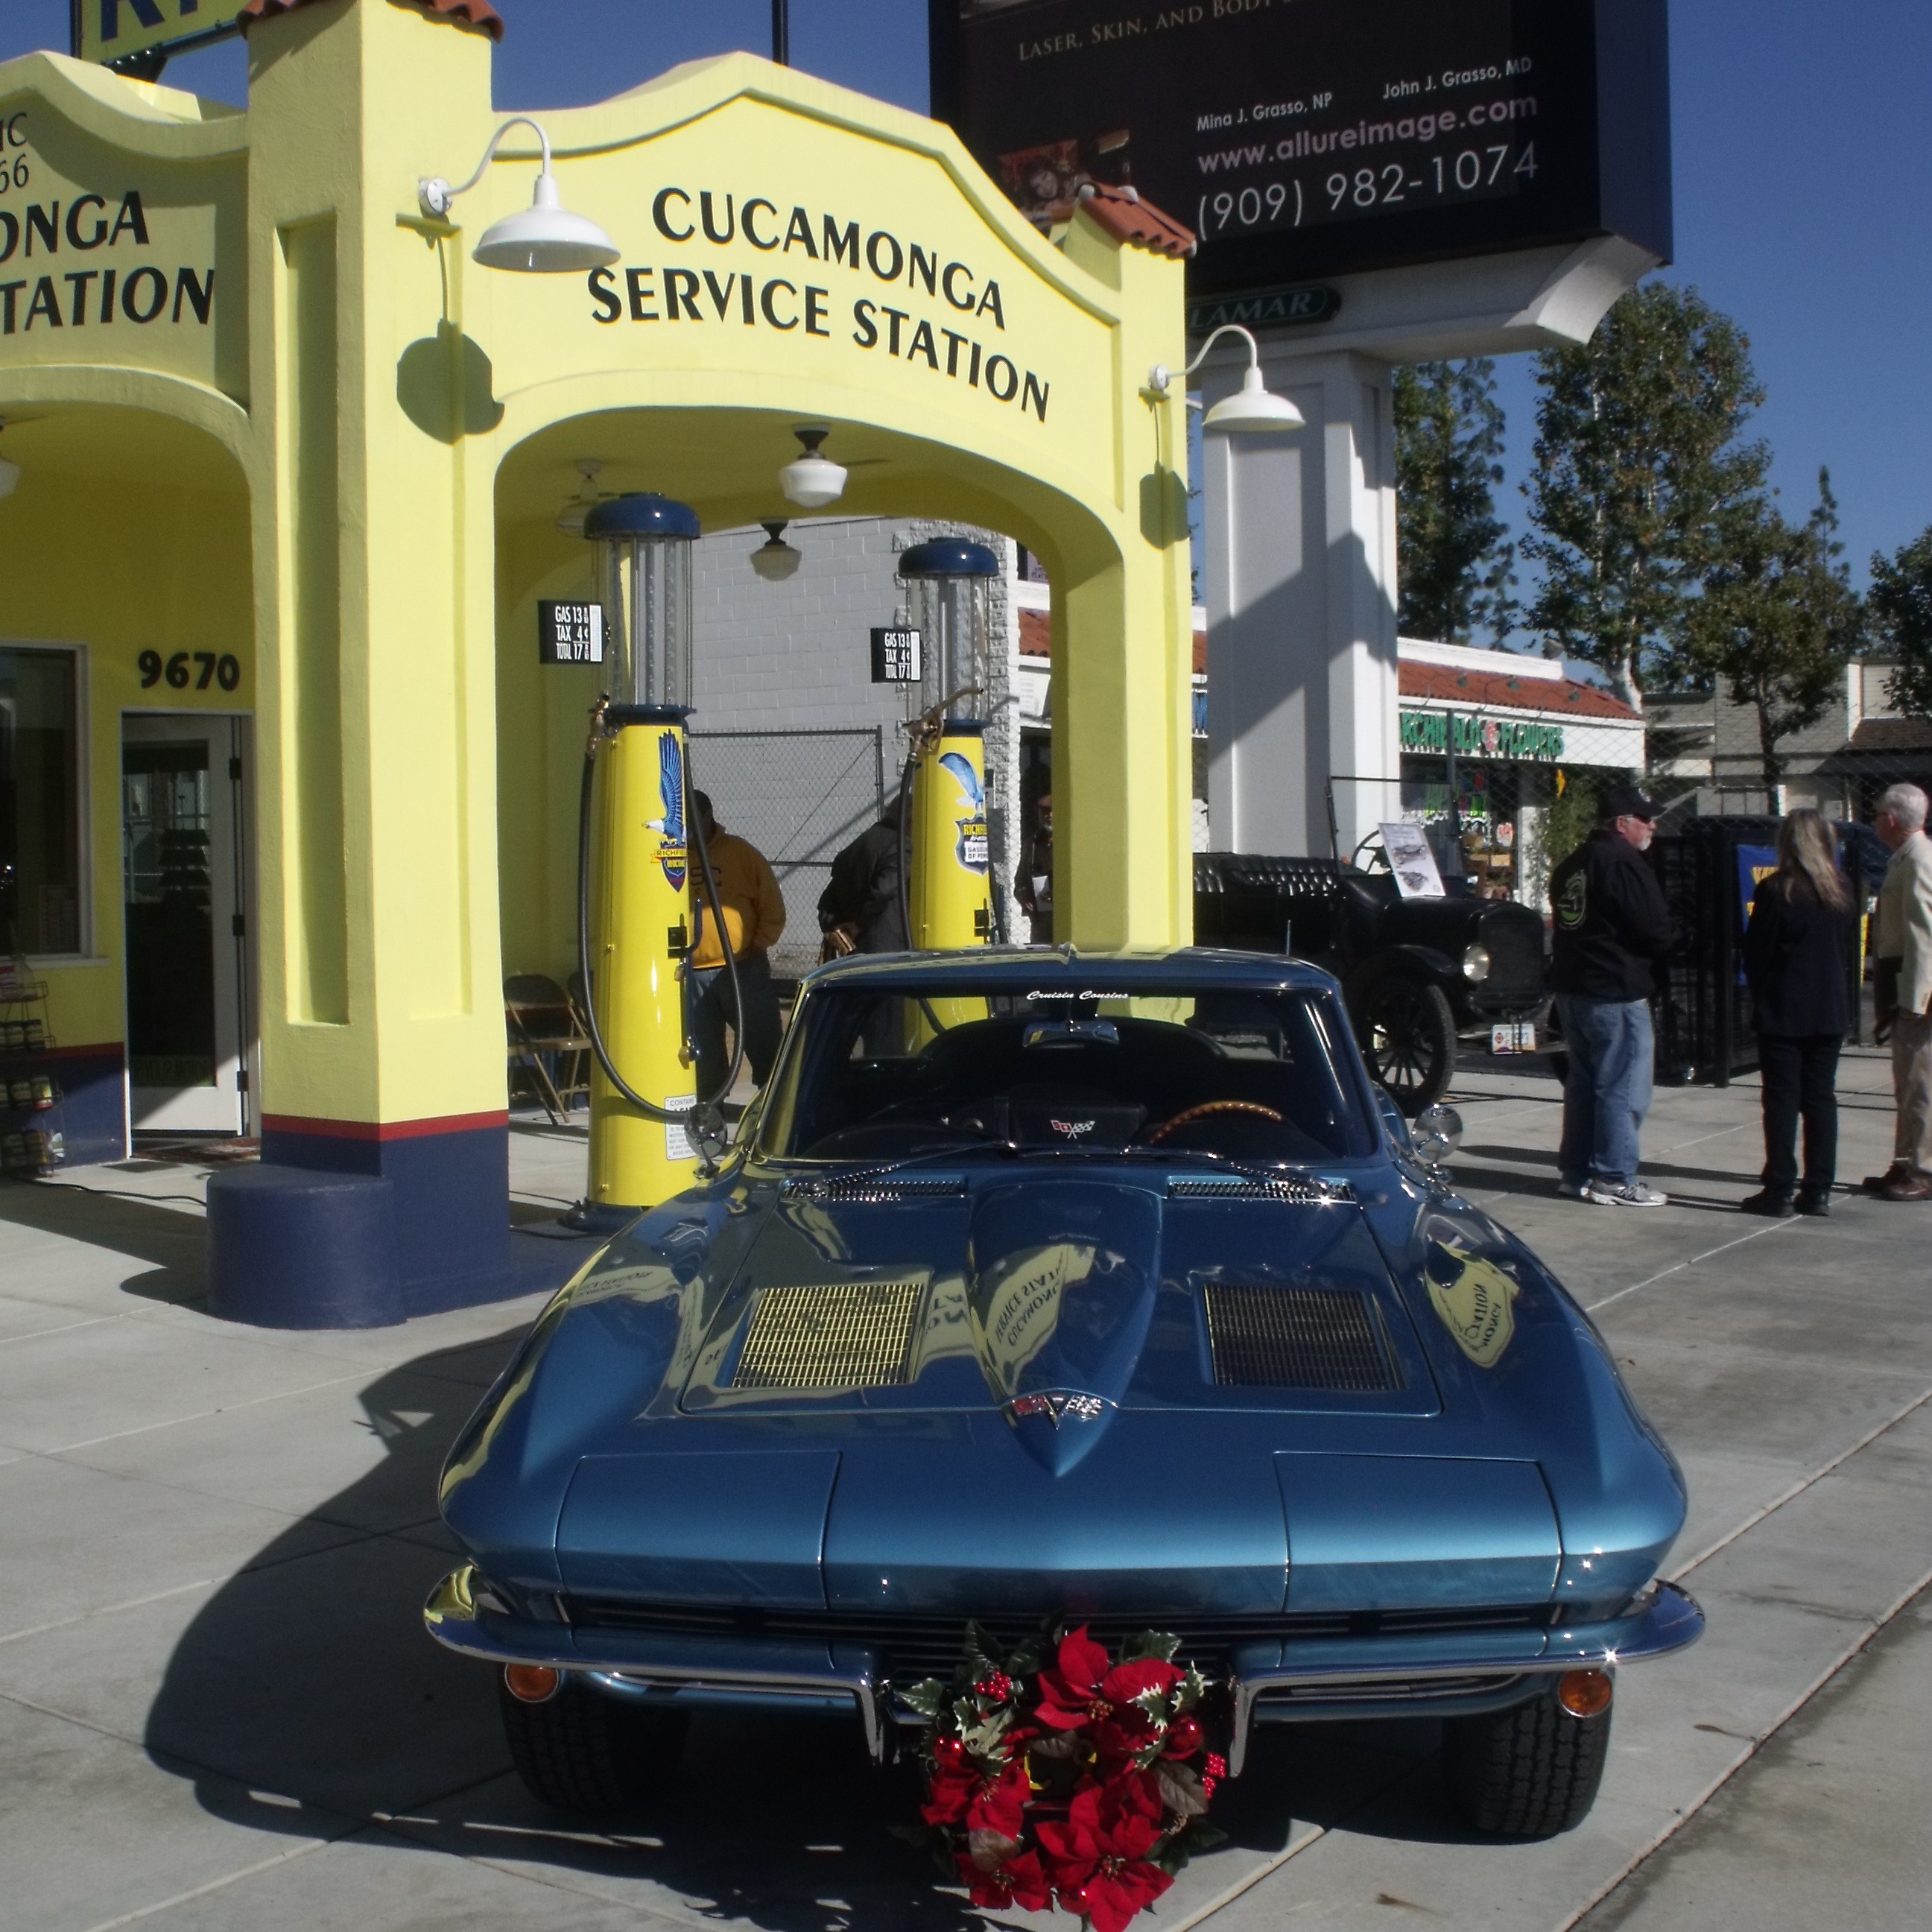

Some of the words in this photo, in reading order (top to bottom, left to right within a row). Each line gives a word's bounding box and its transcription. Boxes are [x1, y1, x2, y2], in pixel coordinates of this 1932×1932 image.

[1382, 80, 1419, 99] John
[1425, 75, 1437, 91] J.
[1442, 66, 1501, 87] Grasso,
[1505, 56, 1532, 76] MD
[1197, 113, 1232, 131] Mina
[1237, 108, 1248, 123] J.
[1252, 101, 1308, 120] Grasso,
[1312, 91, 1332, 110] NP
[1197, 95, 1537, 174] www.allureimage.com
[1198, 179, 1303, 241] (909)
[1326, 142, 1539, 212] 982-1074
[652, 187, 1005, 332] CUCAMONGA
[1189, 292, 1312, 328] LAMAR
[587, 266, 830, 338] SERVICE
[852, 299, 1050, 423] STATION
[555, 606, 571, 623] GAS
[572, 606, 582, 624] 13
[555, 624, 571, 642] TAX
[556, 642, 572, 660] TOTAL
[574, 643, 583, 660] 17
[884, 633, 897, 647] GAS
[884, 648, 897, 663] TAX
[138, 650, 240, 691] 9670
[1026, 990, 1074, 1001] Cruisin
[1078, 990, 1129, 1001] Cousins
